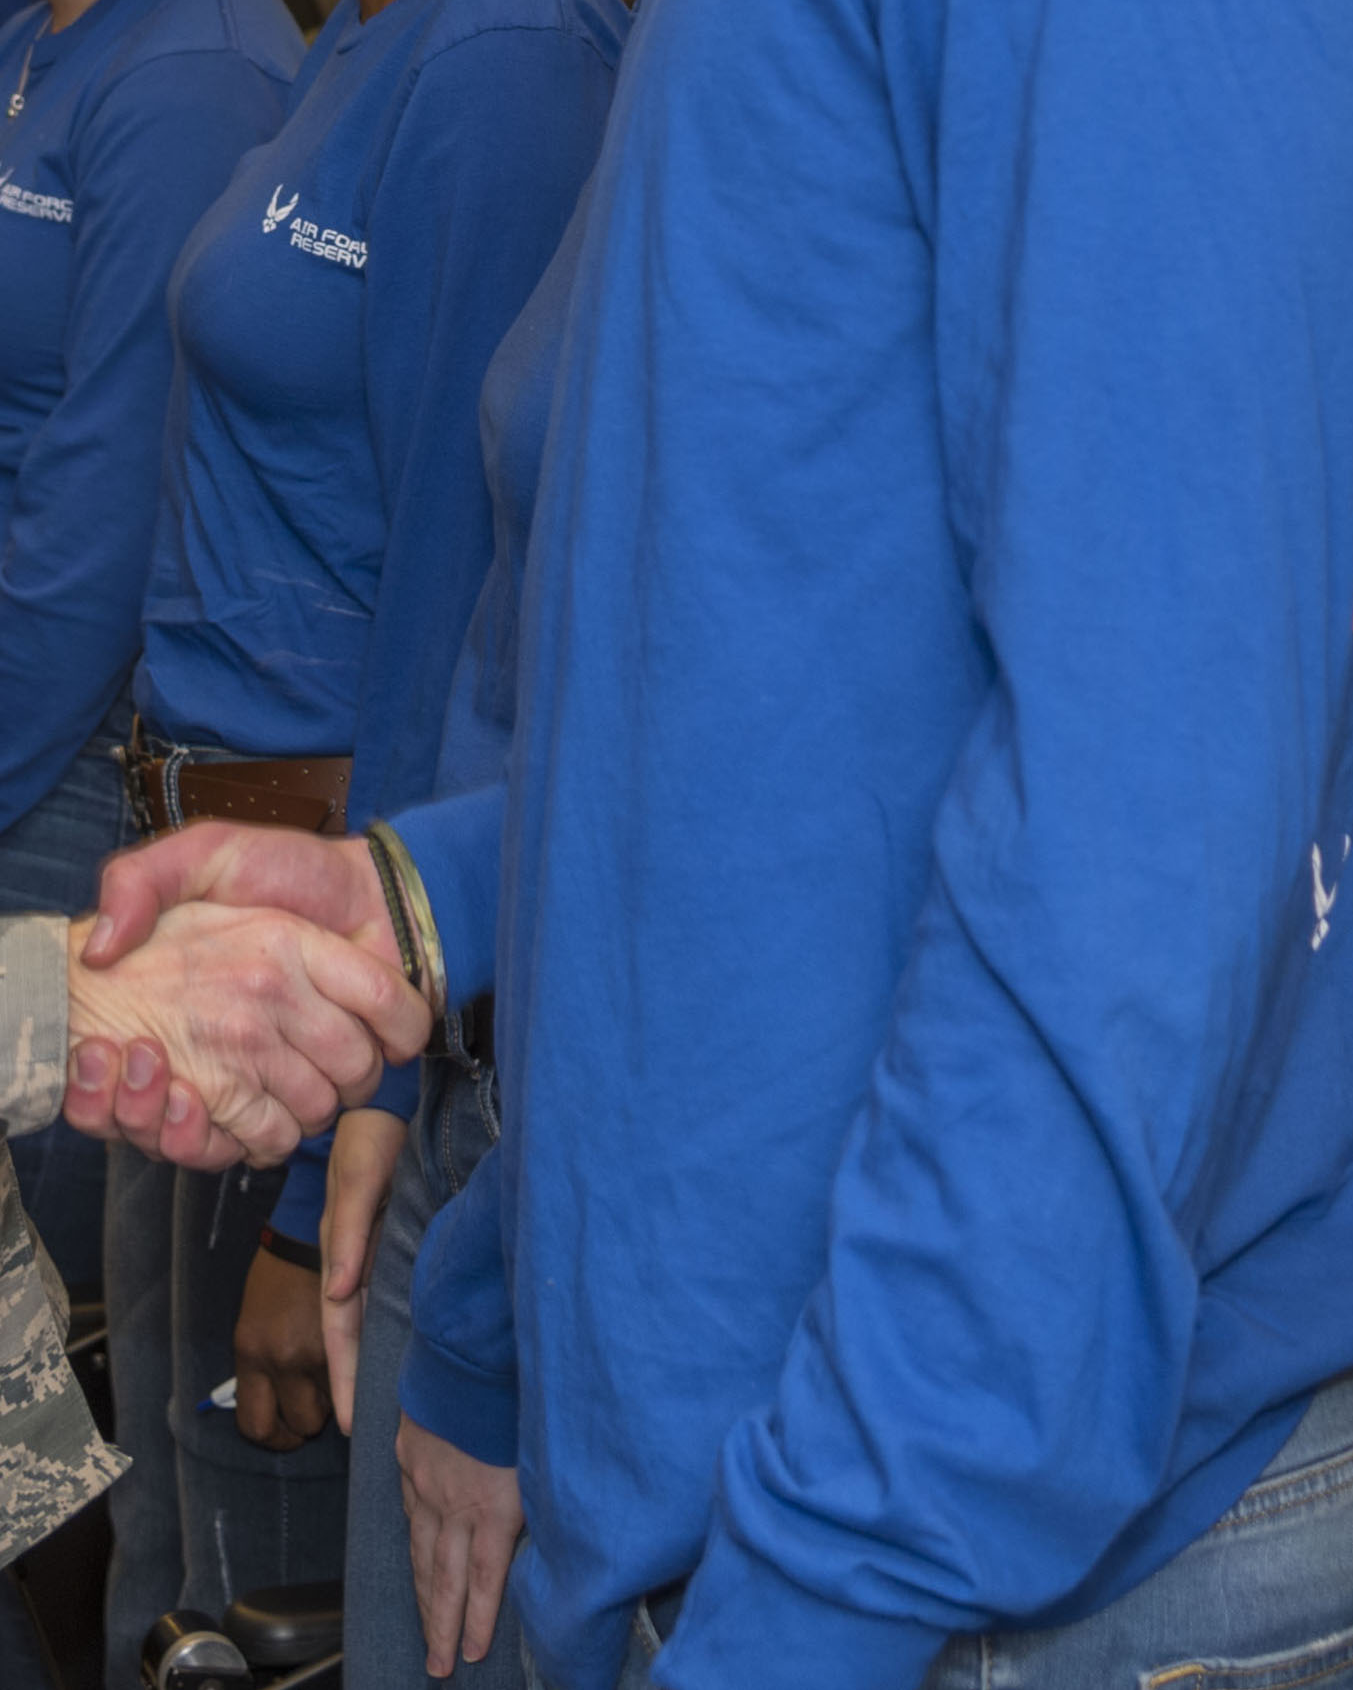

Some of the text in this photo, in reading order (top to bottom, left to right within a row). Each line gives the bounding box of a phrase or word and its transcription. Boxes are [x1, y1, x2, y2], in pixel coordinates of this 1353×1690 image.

[22, 190, 74, 211] FORC
[289, 217, 368, 255] AIR FOR
[290, 232, 368, 269] RESERV
